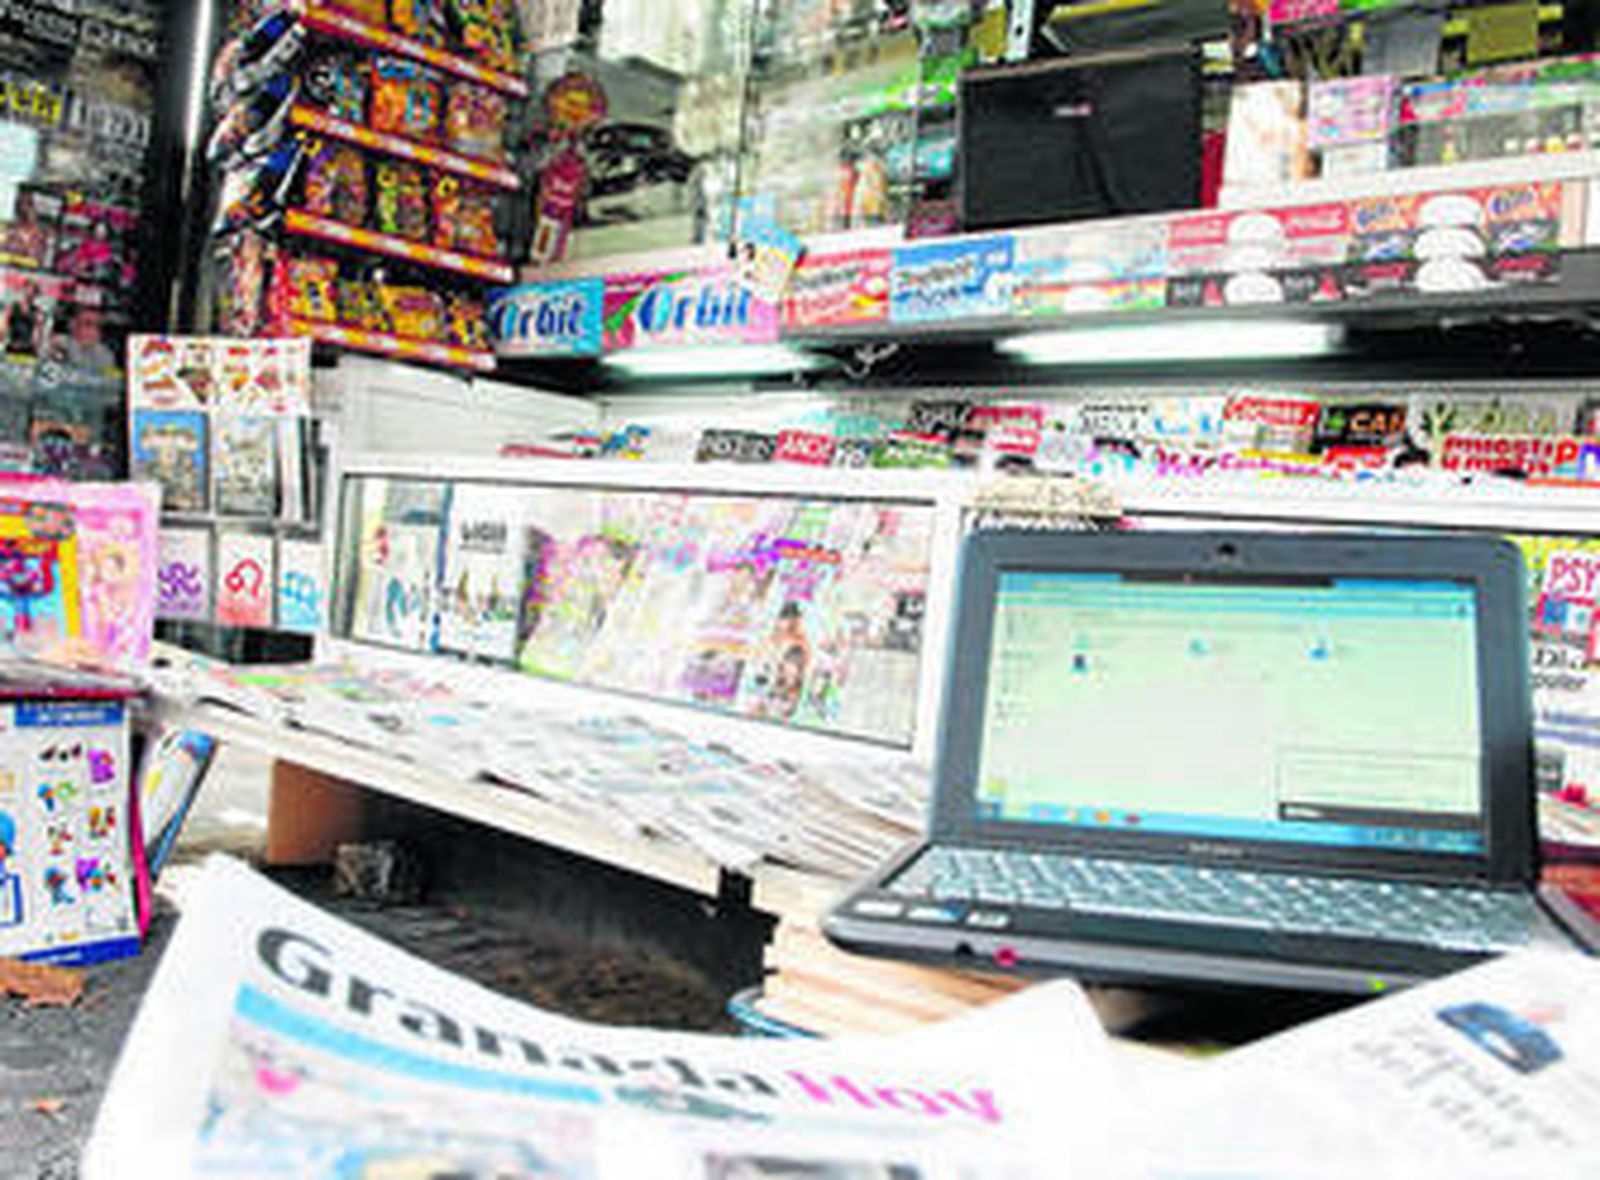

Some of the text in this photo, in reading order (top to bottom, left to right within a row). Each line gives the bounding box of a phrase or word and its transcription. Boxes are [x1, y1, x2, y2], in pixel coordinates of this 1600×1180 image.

[489, 296, 584, 343] Orbit
[637, 284, 751, 333] Orbit
[256, 927, 1003, 1123] Granada Hoy
